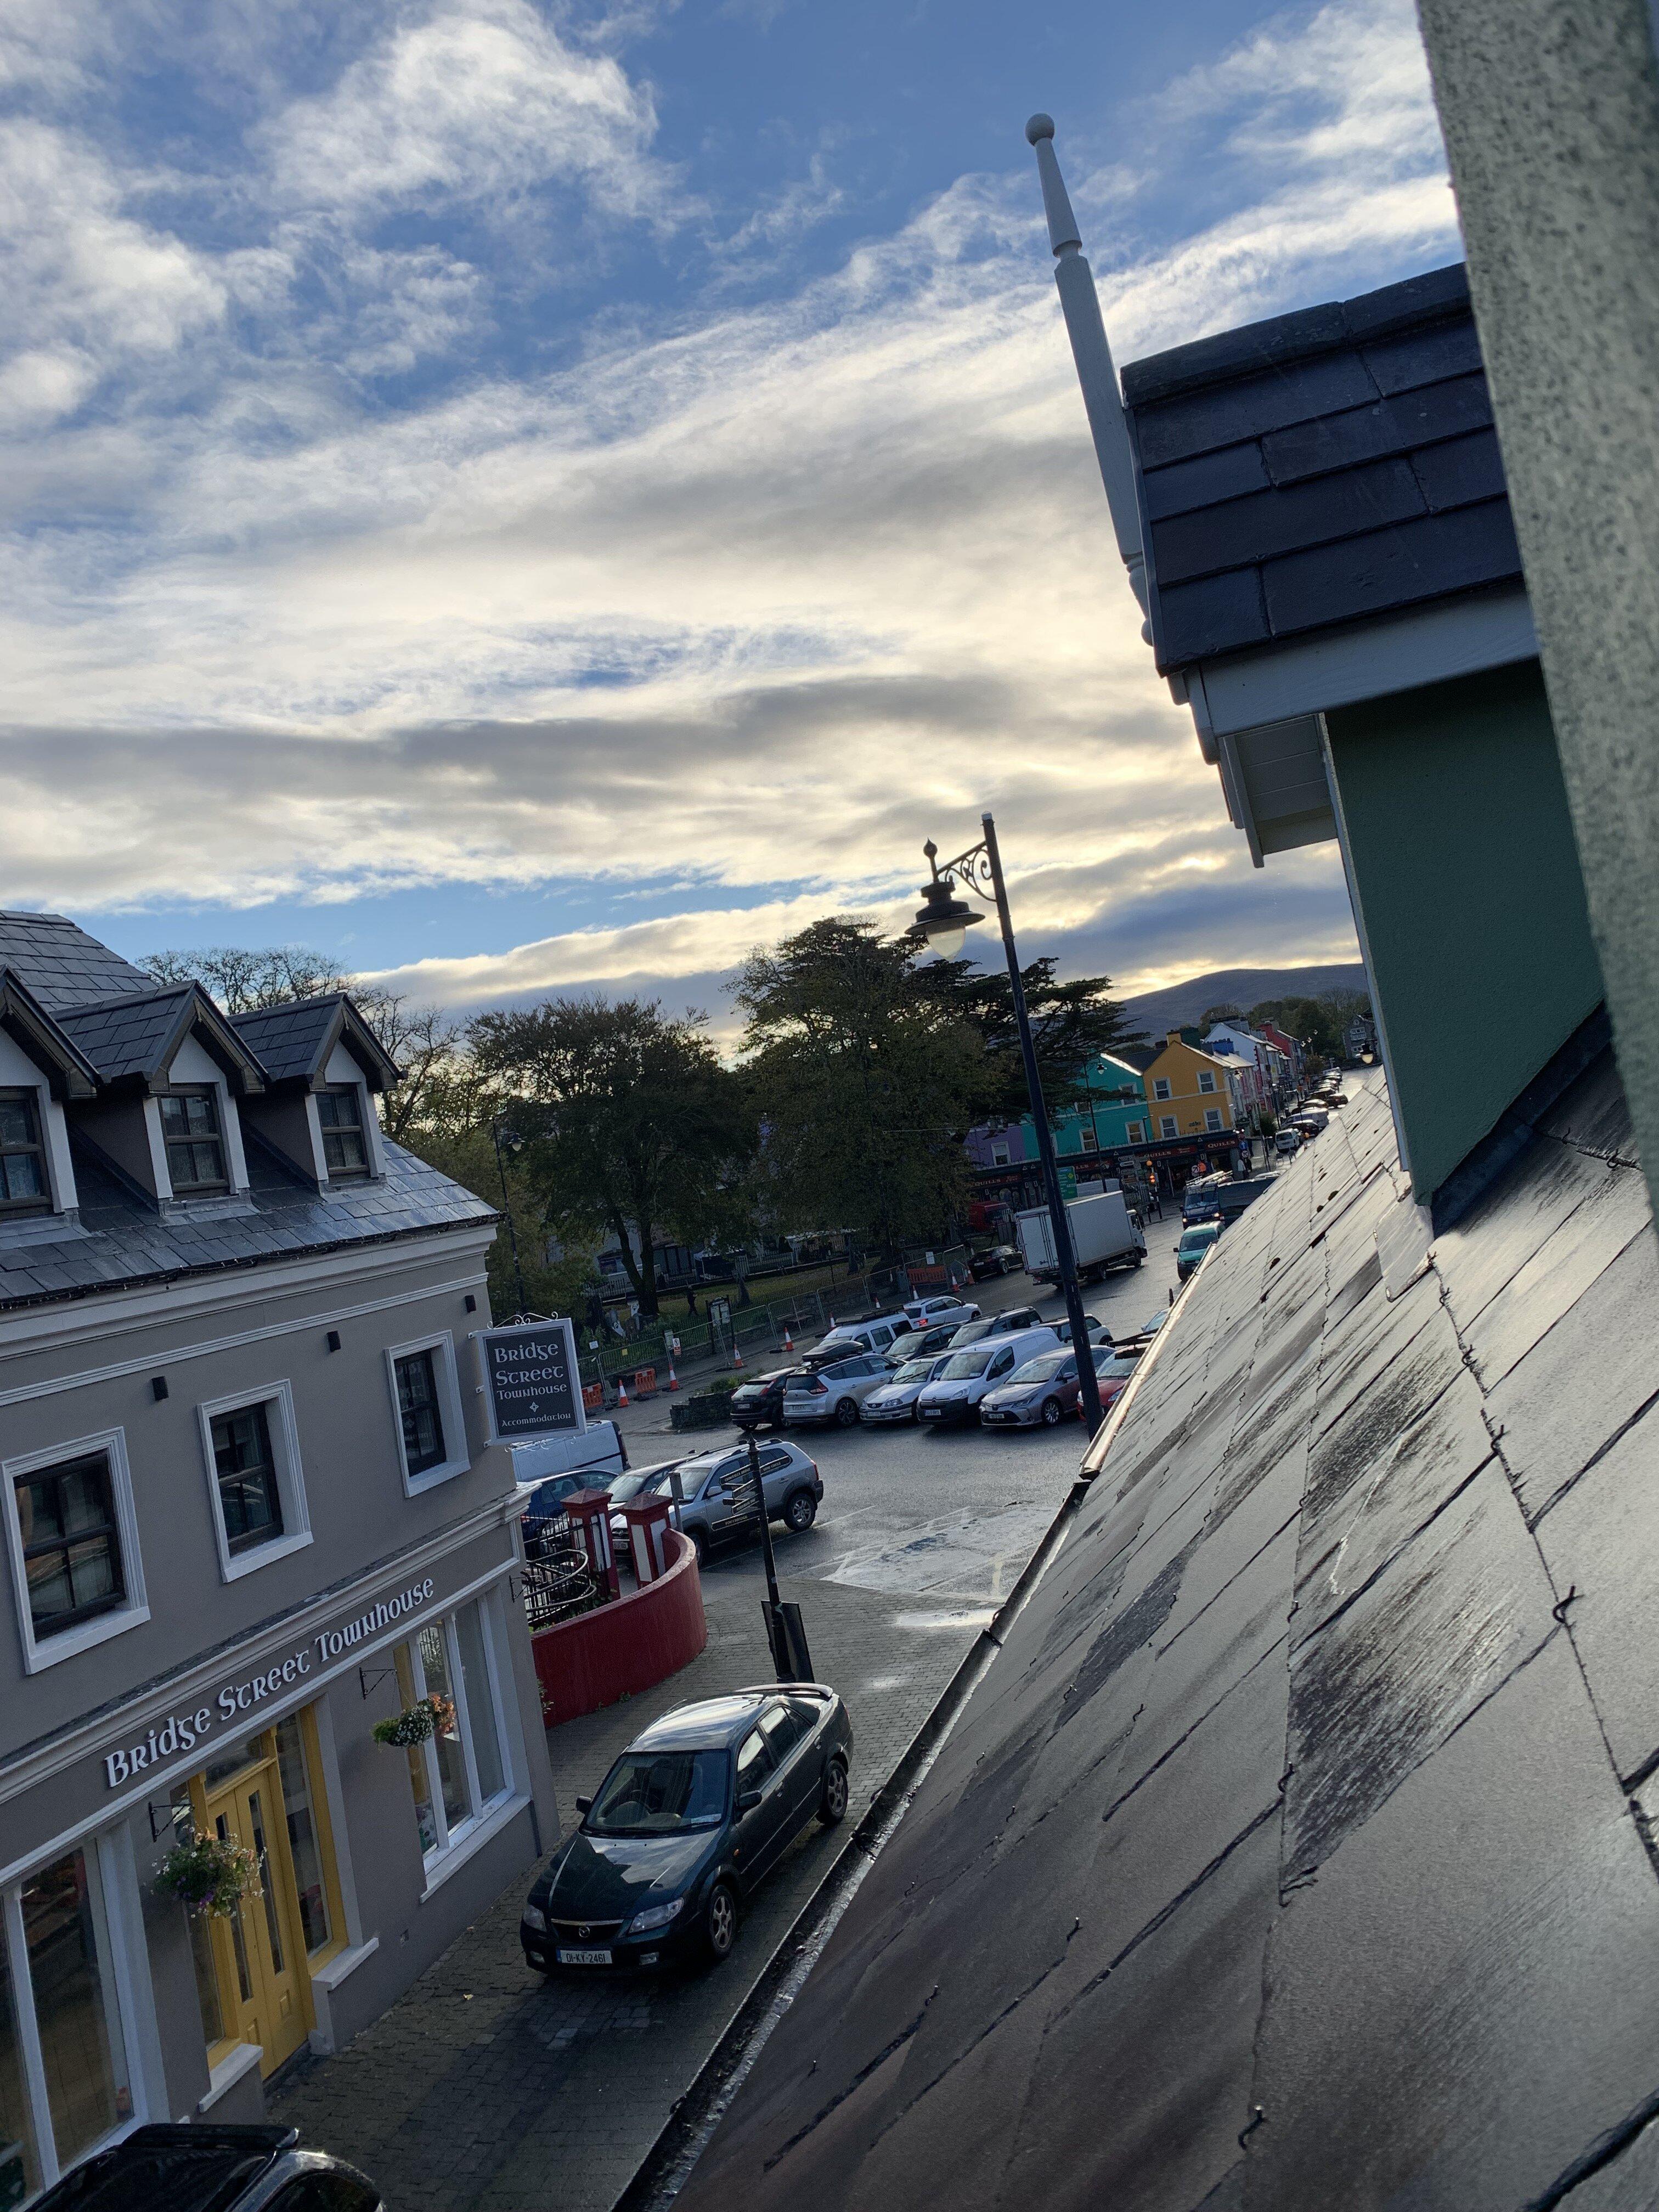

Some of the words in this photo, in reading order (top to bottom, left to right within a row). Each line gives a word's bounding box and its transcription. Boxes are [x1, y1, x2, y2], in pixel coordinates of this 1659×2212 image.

[494, 1342, 559, 1363] Bridge
[495, 1365, 564, 1386] Street
[496, 1384, 567, 1400] Townhouse
[502, 1413, 571, 1427] Accommodation
[104, 1708, 211, 1788] Bridge
[218, 1650, 311, 1722] Street
[315, 1578, 434, 1662] Townhouse
